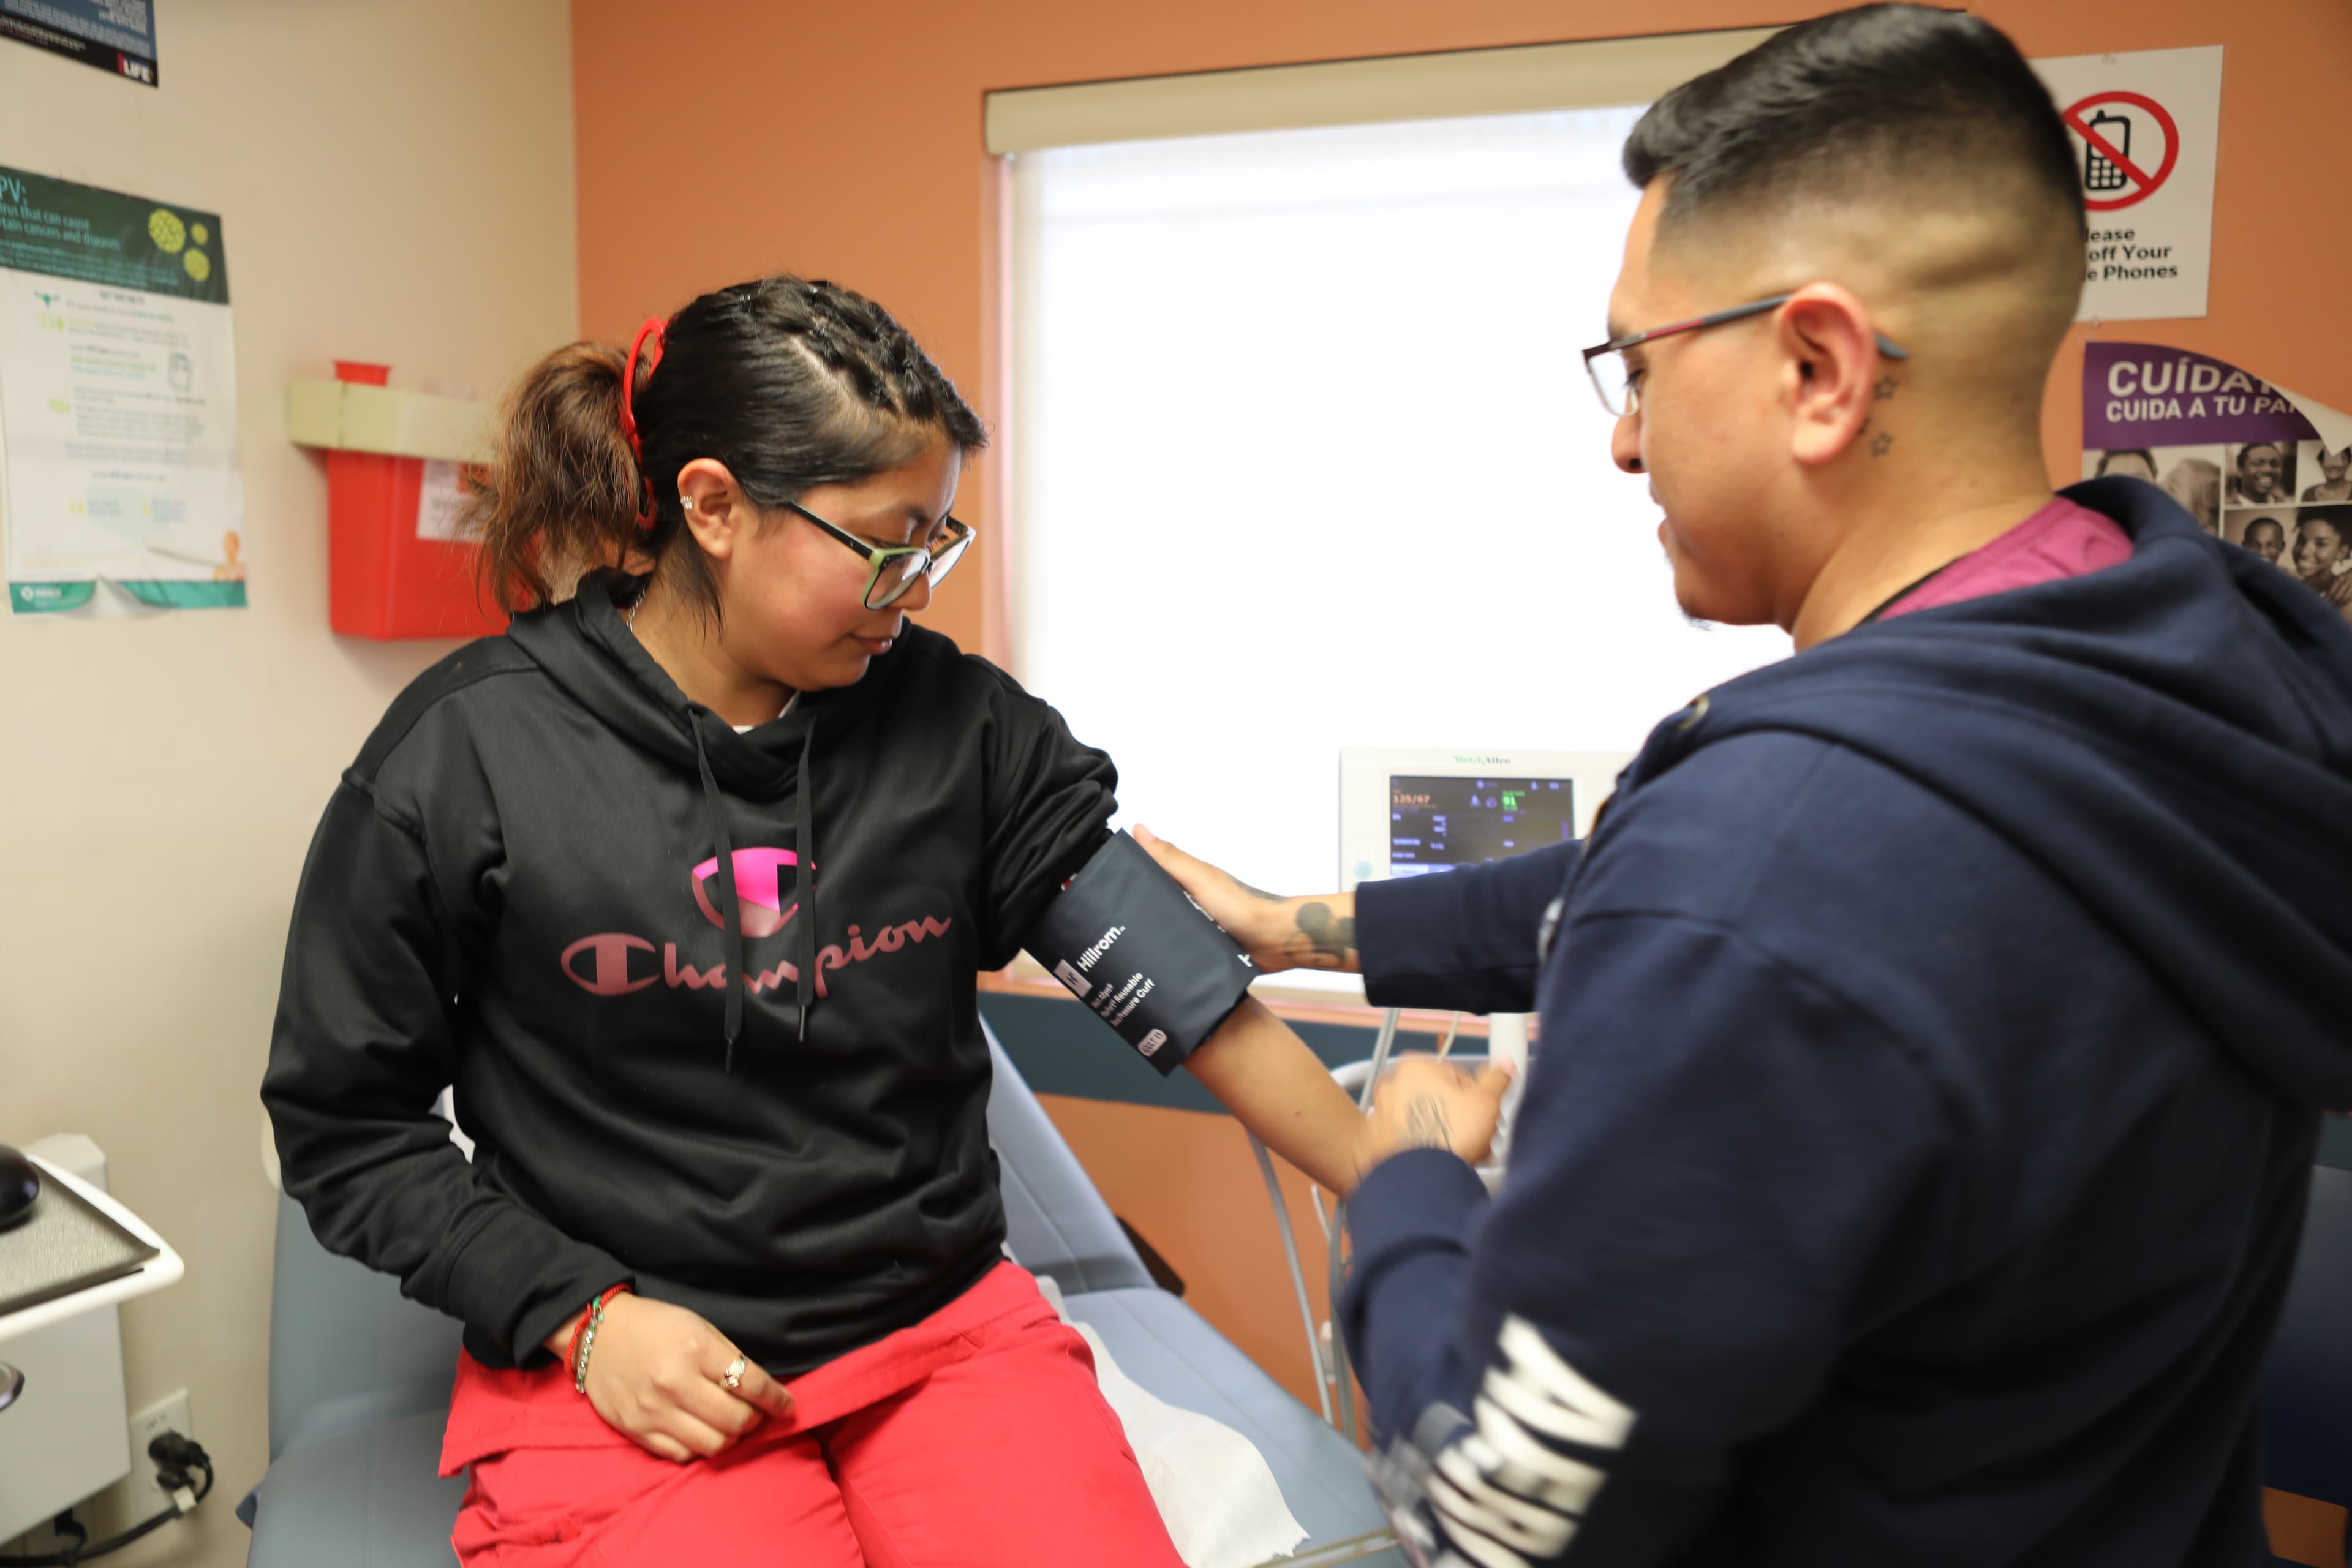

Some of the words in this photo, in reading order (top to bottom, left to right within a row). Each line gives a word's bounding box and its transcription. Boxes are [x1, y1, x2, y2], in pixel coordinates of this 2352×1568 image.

[0, 175, 28, 205] PV:
[2085, 228, 2135, 243] lease
[2089, 246, 2116, 262] off
[2122, 244, 2173, 260] Your
[2104, 263, 2177, 281] Phones
[2106, 398, 2183, 423] CUIDA
[2188, 396, 2207, 418] A
[2212, 395, 2246, 417] TU
[2253, 397, 2294, 415] PA
[560, 915, 951, 998] Champion
[1114, 973, 1143, 1003] Reusable
[1136, 978, 1155, 998] Cuff
